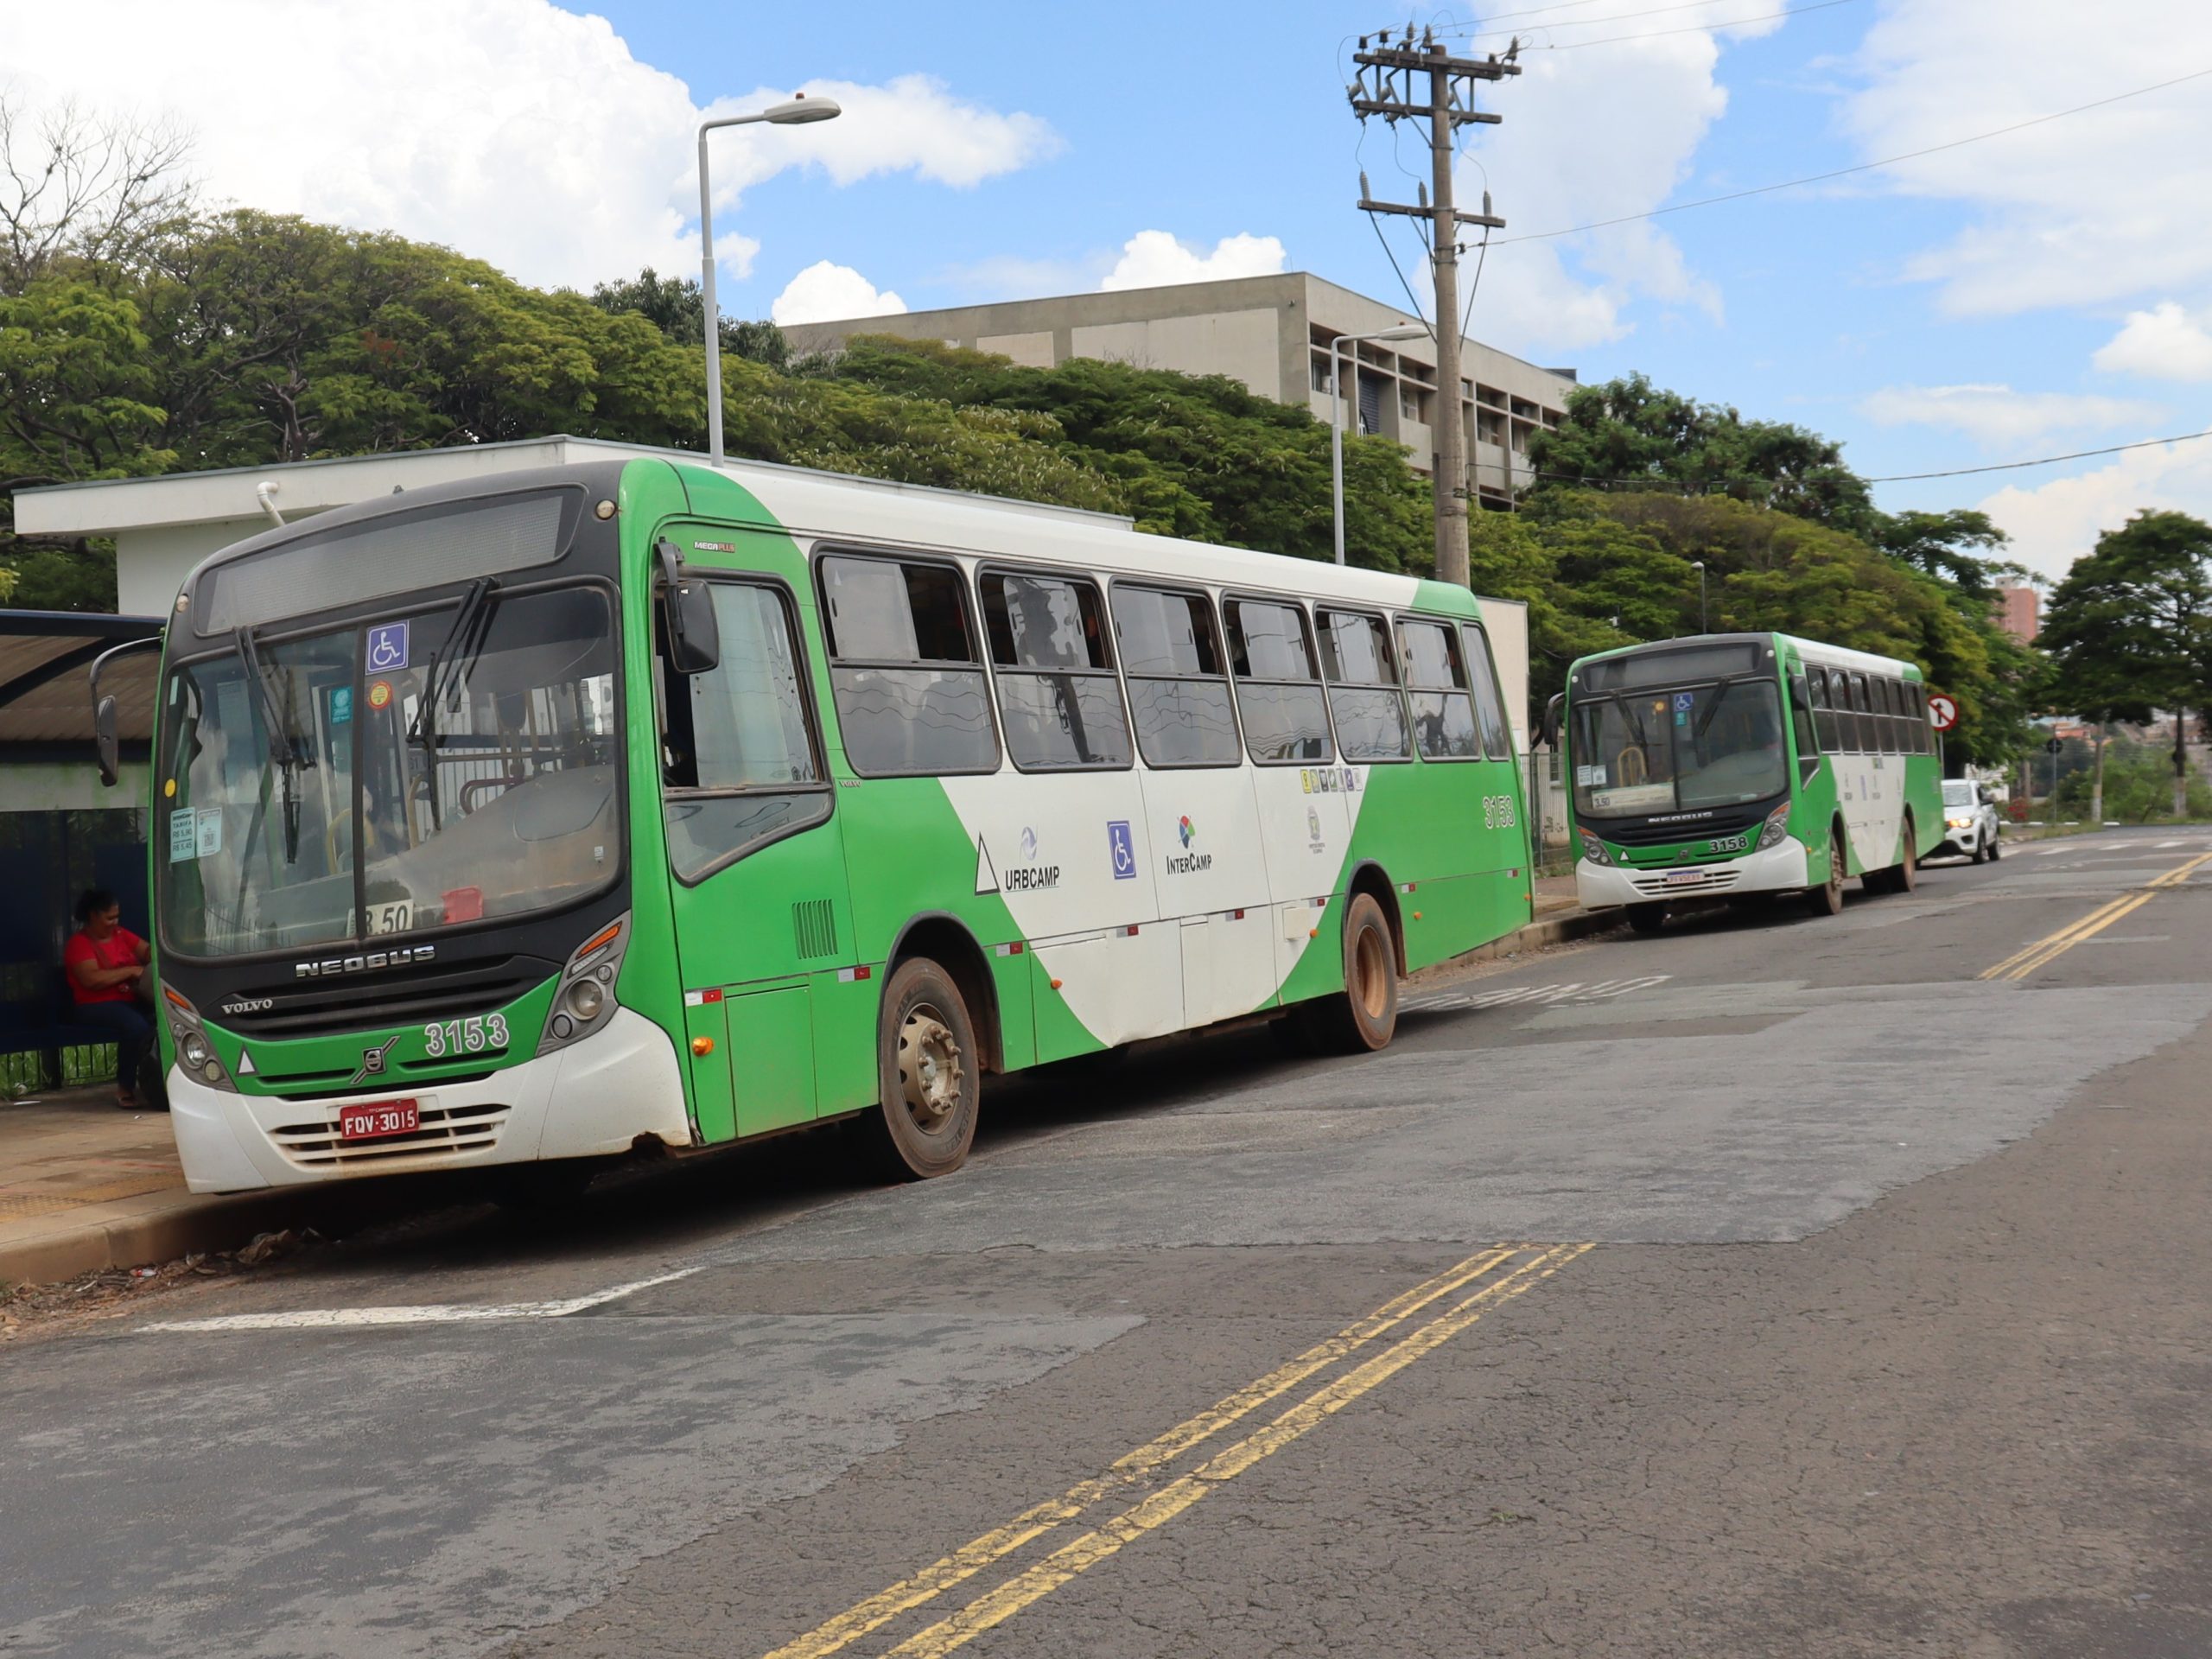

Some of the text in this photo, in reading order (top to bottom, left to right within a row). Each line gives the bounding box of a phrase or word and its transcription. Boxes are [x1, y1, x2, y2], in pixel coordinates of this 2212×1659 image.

[1483, 795, 1516, 830] 3153
[1710, 836, 1749, 854] 3158
[1005, 866, 1060, 891] URBCAMP
[296, 945, 435, 978] NEOBUS
[221, 999, 273, 1015] VOLVO
[424, 1013, 510, 1058] 3153
